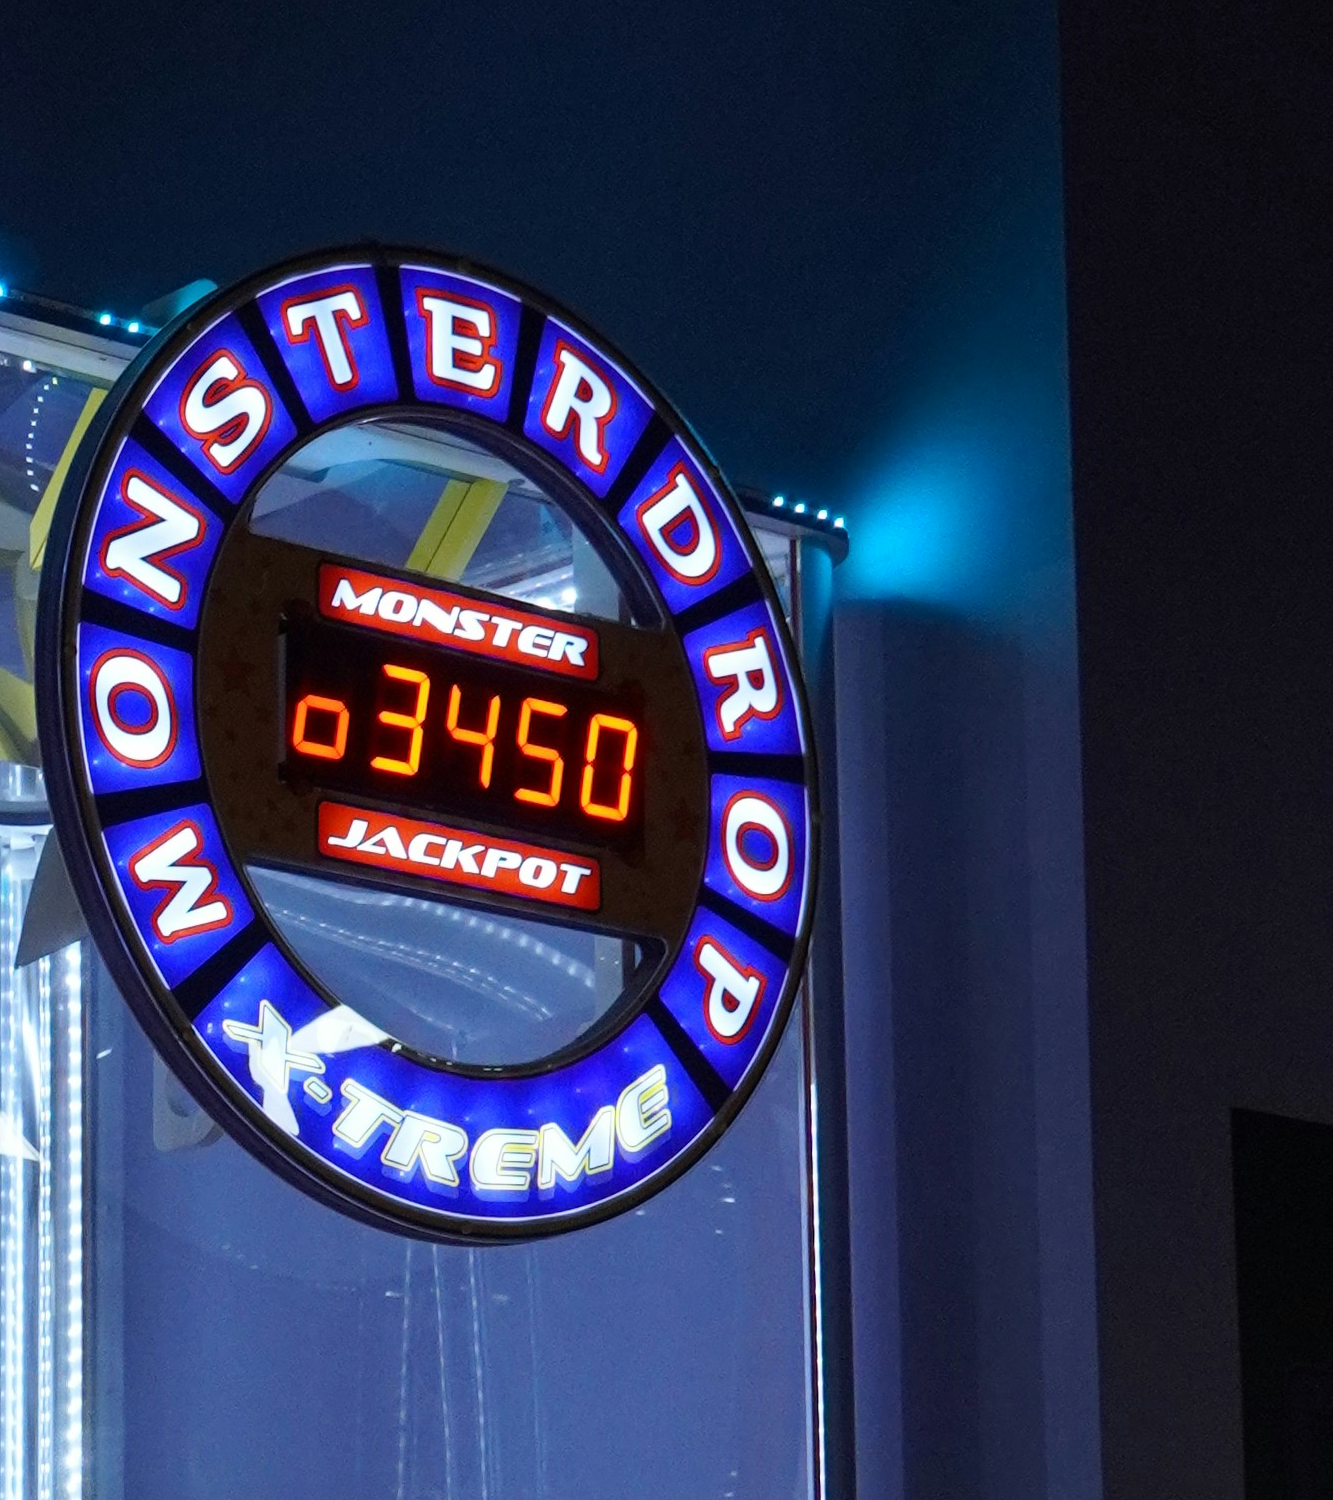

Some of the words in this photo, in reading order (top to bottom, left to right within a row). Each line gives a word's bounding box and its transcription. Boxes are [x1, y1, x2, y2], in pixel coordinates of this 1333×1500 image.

[91, 284, 617, 943] MONSTER
[638, 460, 793, 1045] DROP
[331, 580, 589, 668] MONSTER
[327, 819, 591, 896] JACKPOT
[223, 1001, 673, 1191] X-TREME
